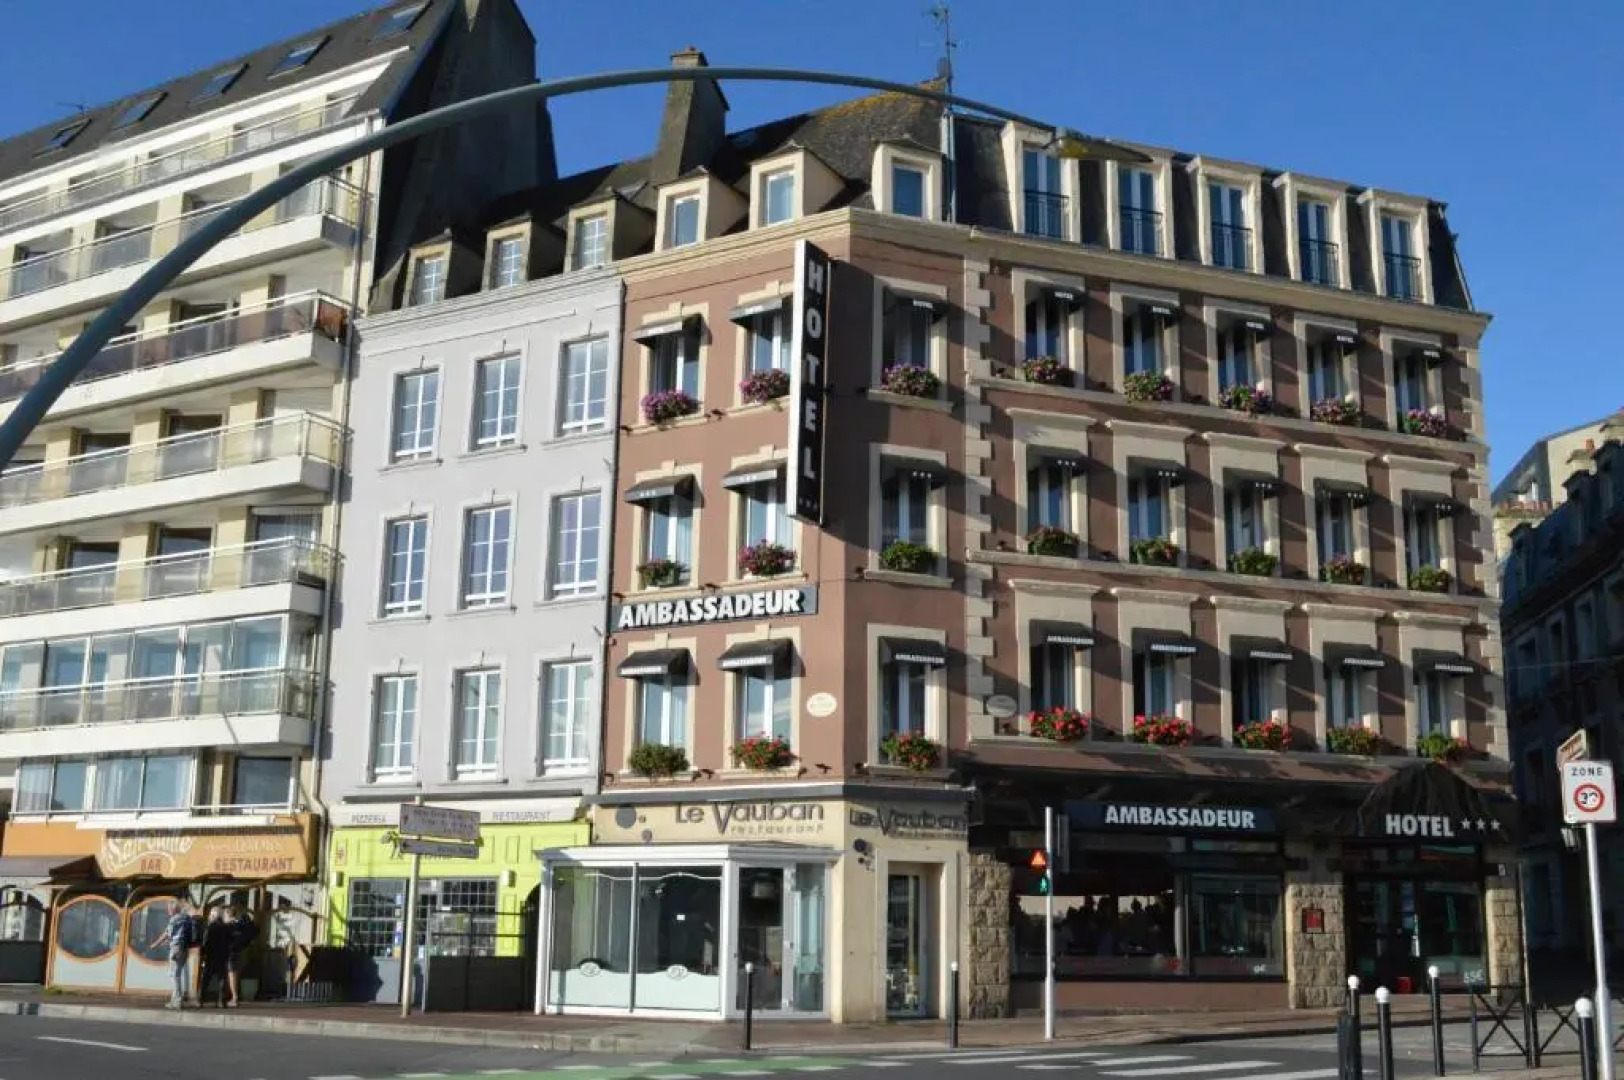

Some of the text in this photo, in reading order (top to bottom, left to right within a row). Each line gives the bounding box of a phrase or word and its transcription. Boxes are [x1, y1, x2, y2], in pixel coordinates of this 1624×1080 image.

[803, 259, 824, 480] HOTEL
[618, 589, 801, 628] AMBASSADEUR
[1571, 766, 1603, 777] ZONE
[675, 800, 824, 835] Le Vauban
[1105, 805, 1256, 829] AMBASSADEUR
[1385, 813, 1455, 837] HOTEL
[140, 858, 164, 873] BAR
[215, 856, 295, 874] RESTAURANT
